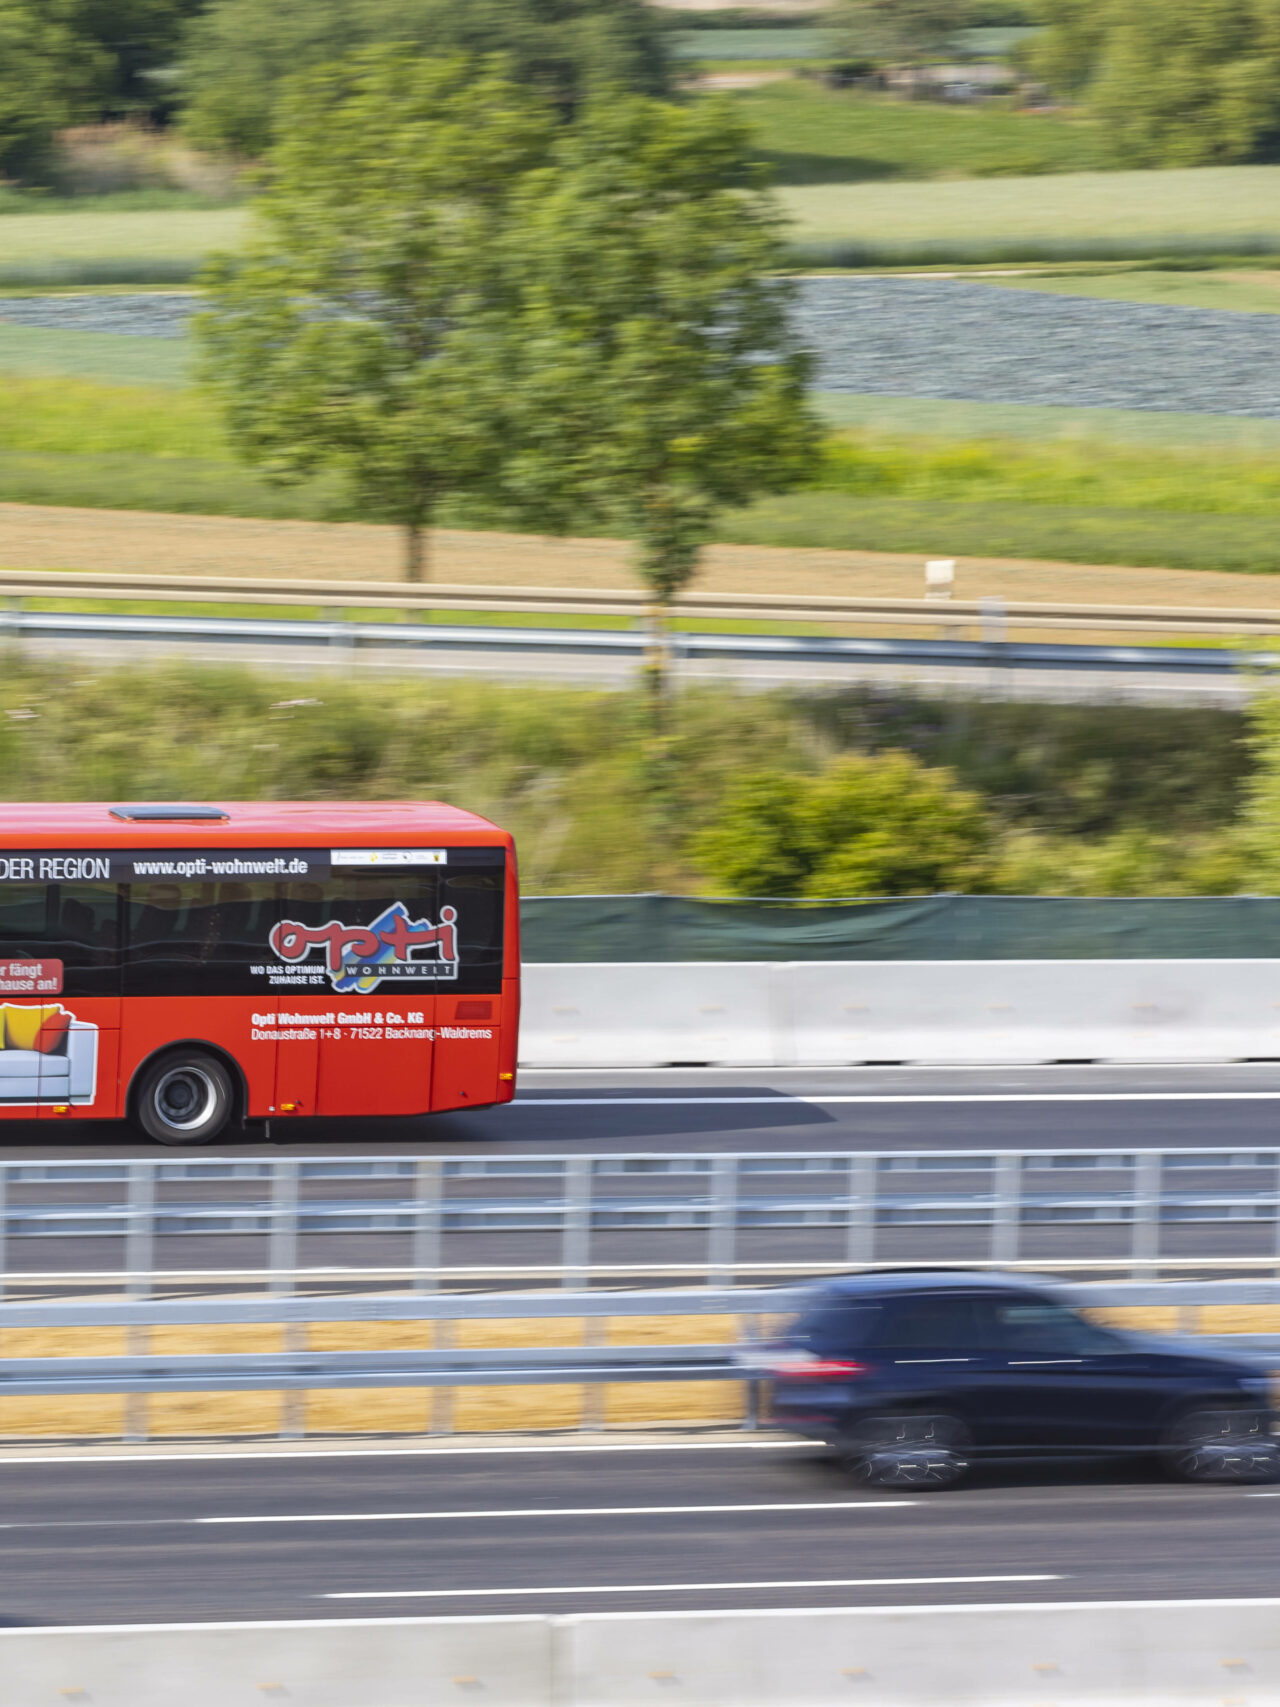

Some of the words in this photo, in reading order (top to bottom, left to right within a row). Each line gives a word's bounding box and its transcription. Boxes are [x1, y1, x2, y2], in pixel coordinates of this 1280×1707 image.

[39, 858, 110, 880] REGION
[133, 858, 309, 877] www.opti-wohnwelt.de
[272, 908, 456, 973] opti
[9, 963, 43, 979] fängt
[250, 965, 265, 975] WO
[266, 965, 284, 975] DAS
[285, 965, 326, 975] OPTIMUM
[346, 964, 452, 976] WOHNWELT
[37, 977, 58, 990] an!
[269, 975, 308, 985] ZUHAUSE
[309, 975, 326, 985] IST.
[251, 1013, 276, 1027] Opti
[278, 1012, 336, 1025] Wohnwelt
[337, 1012, 372, 1025] GmbH
[373, 1012, 384, 1024] &
[386, 1012, 405, 1024] Co.
[407, 1012, 425, 1024] KG
[251, 1028, 317, 1040] Donaustraße
[319, 1028, 341, 1040] 1+8
[350, 1027, 383, 1039] 71522
[384, 1026, 493, 1041] Backnang-Waldrems
